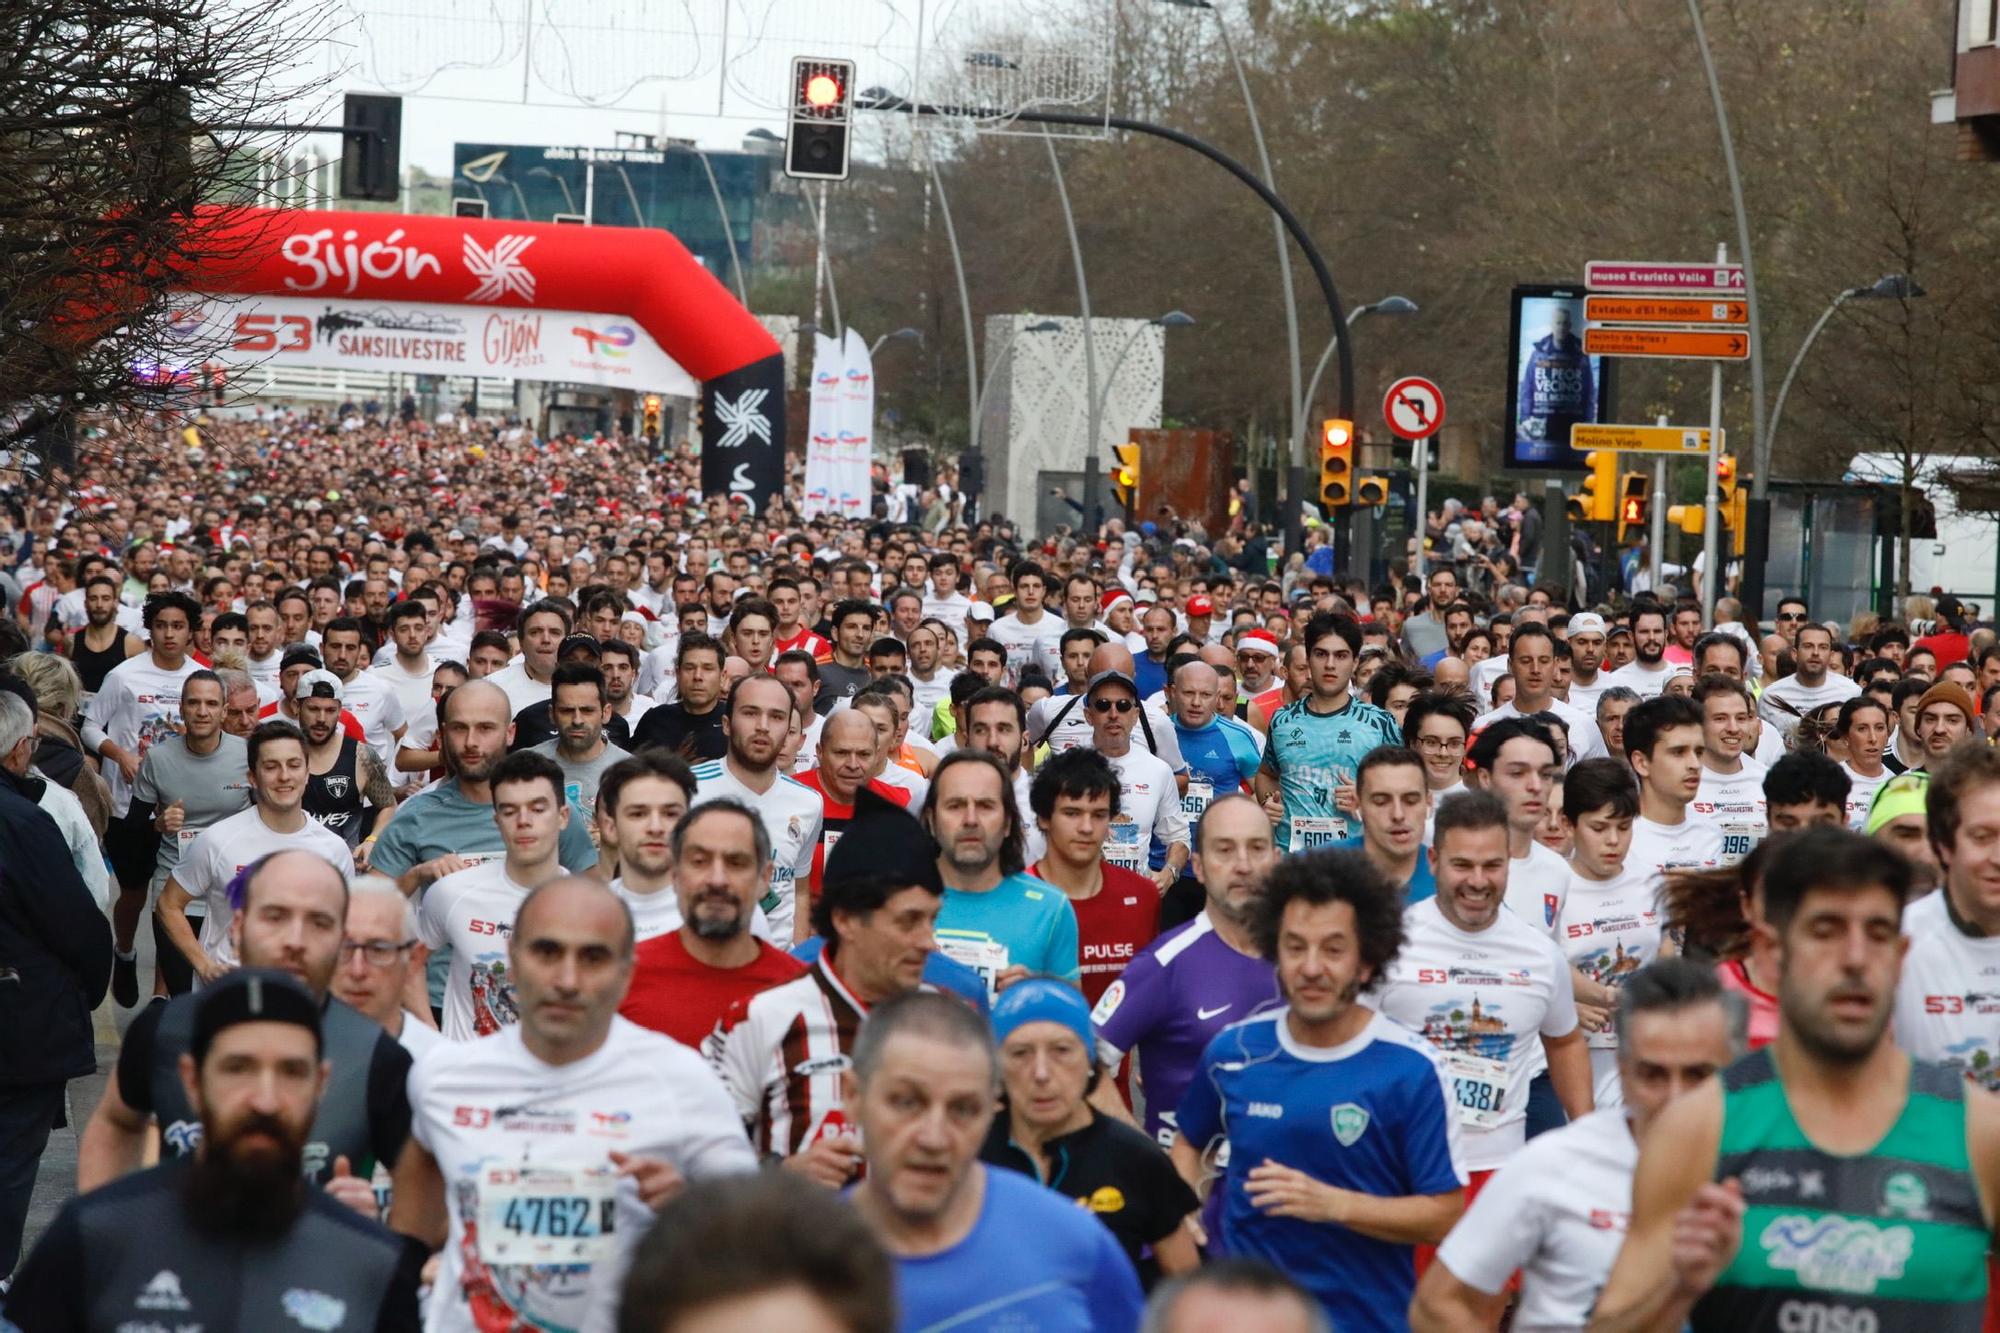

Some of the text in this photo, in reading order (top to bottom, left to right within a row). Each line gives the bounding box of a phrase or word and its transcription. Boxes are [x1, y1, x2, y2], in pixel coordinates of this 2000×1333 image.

[282, 229, 442, 294] gijón
[1592, 271, 1706, 282] museo Evaristo Valle
[236, 314, 312, 352] 53
[338, 333, 466, 362] SANSILVESTRE
[1535, 367, 1547, 379] EL
[1535, 379, 1582, 392] VECINO
[1576, 436, 1642, 449] Molino Viejo
[1693, 803, 1715, 813] 53
[469, 919, 496, 936] 53
[1567, 923, 1594, 939] 53
[1084, 942, 1134, 960] PULSE
[1418, 969, 1447, 984] 53
[1925, 994, 1964, 1015] 53
[453, 1105, 492, 1129] 53
[1247, 1101, 1284, 1119] JAKO
[505, 1196, 593, 1238] 4762
